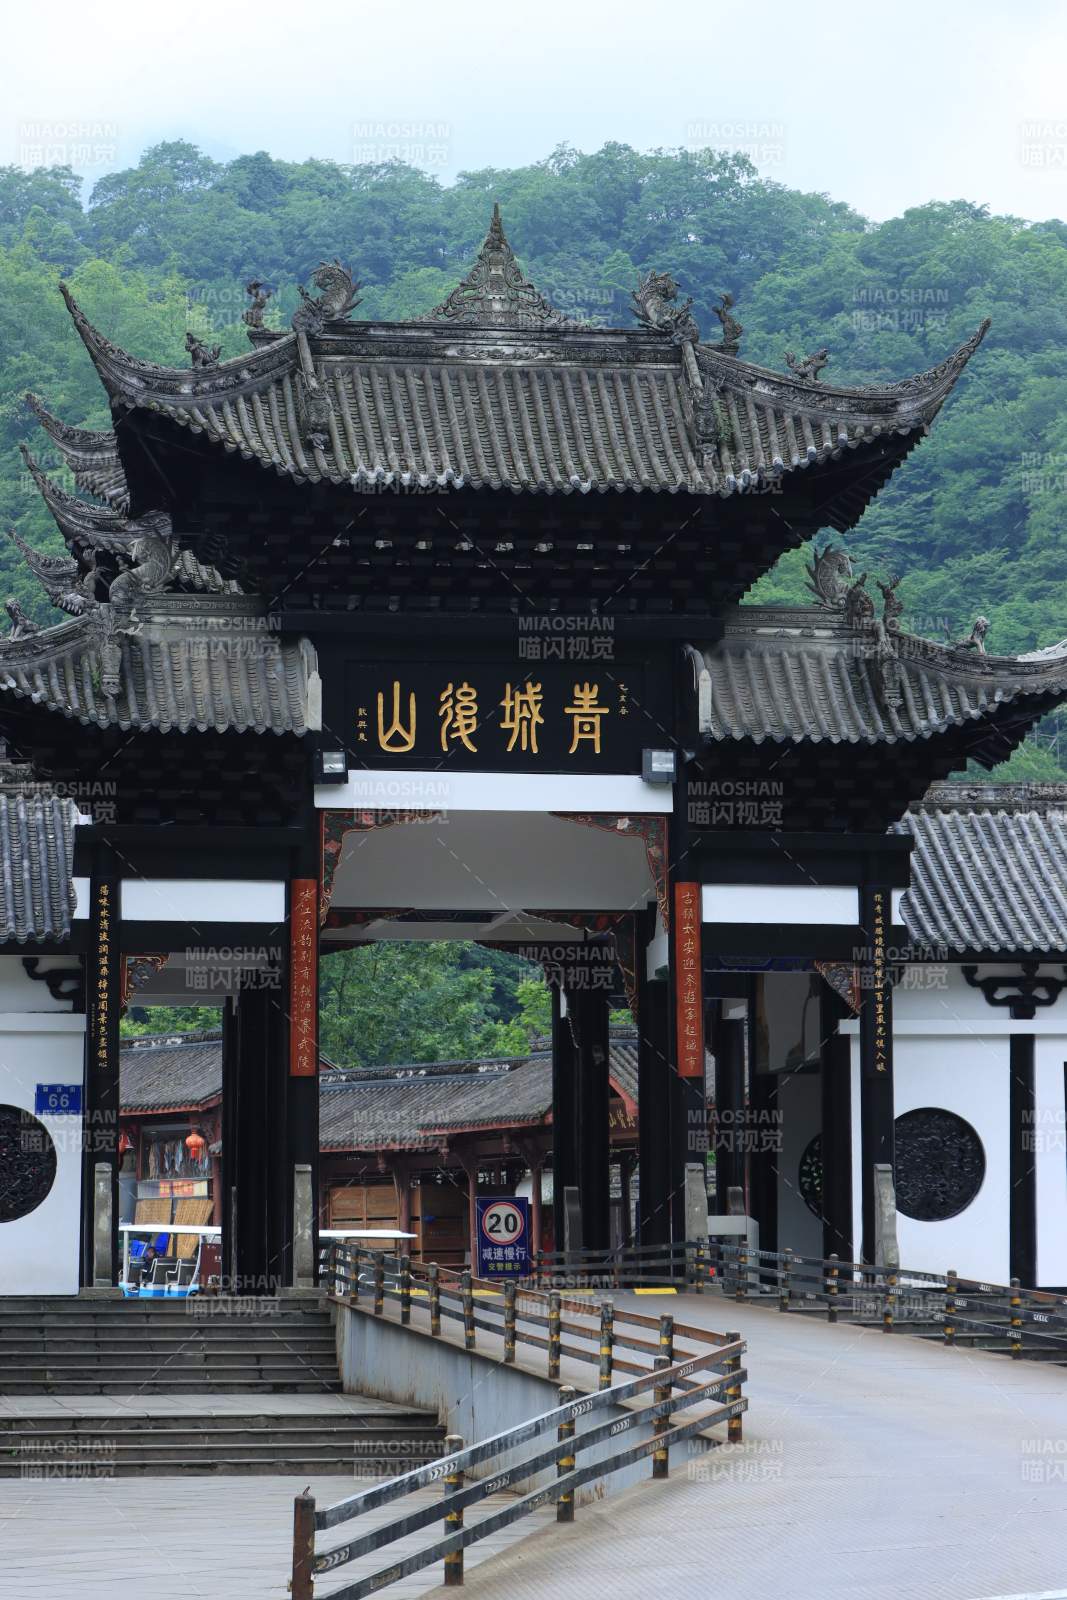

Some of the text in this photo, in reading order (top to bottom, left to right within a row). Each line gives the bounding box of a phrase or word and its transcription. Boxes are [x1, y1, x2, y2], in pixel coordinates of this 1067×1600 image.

[48, 1093, 70, 1108] 66
[488, 1213, 518, 1234] 20
[482, 1247, 527, 1261] 减速慢行
